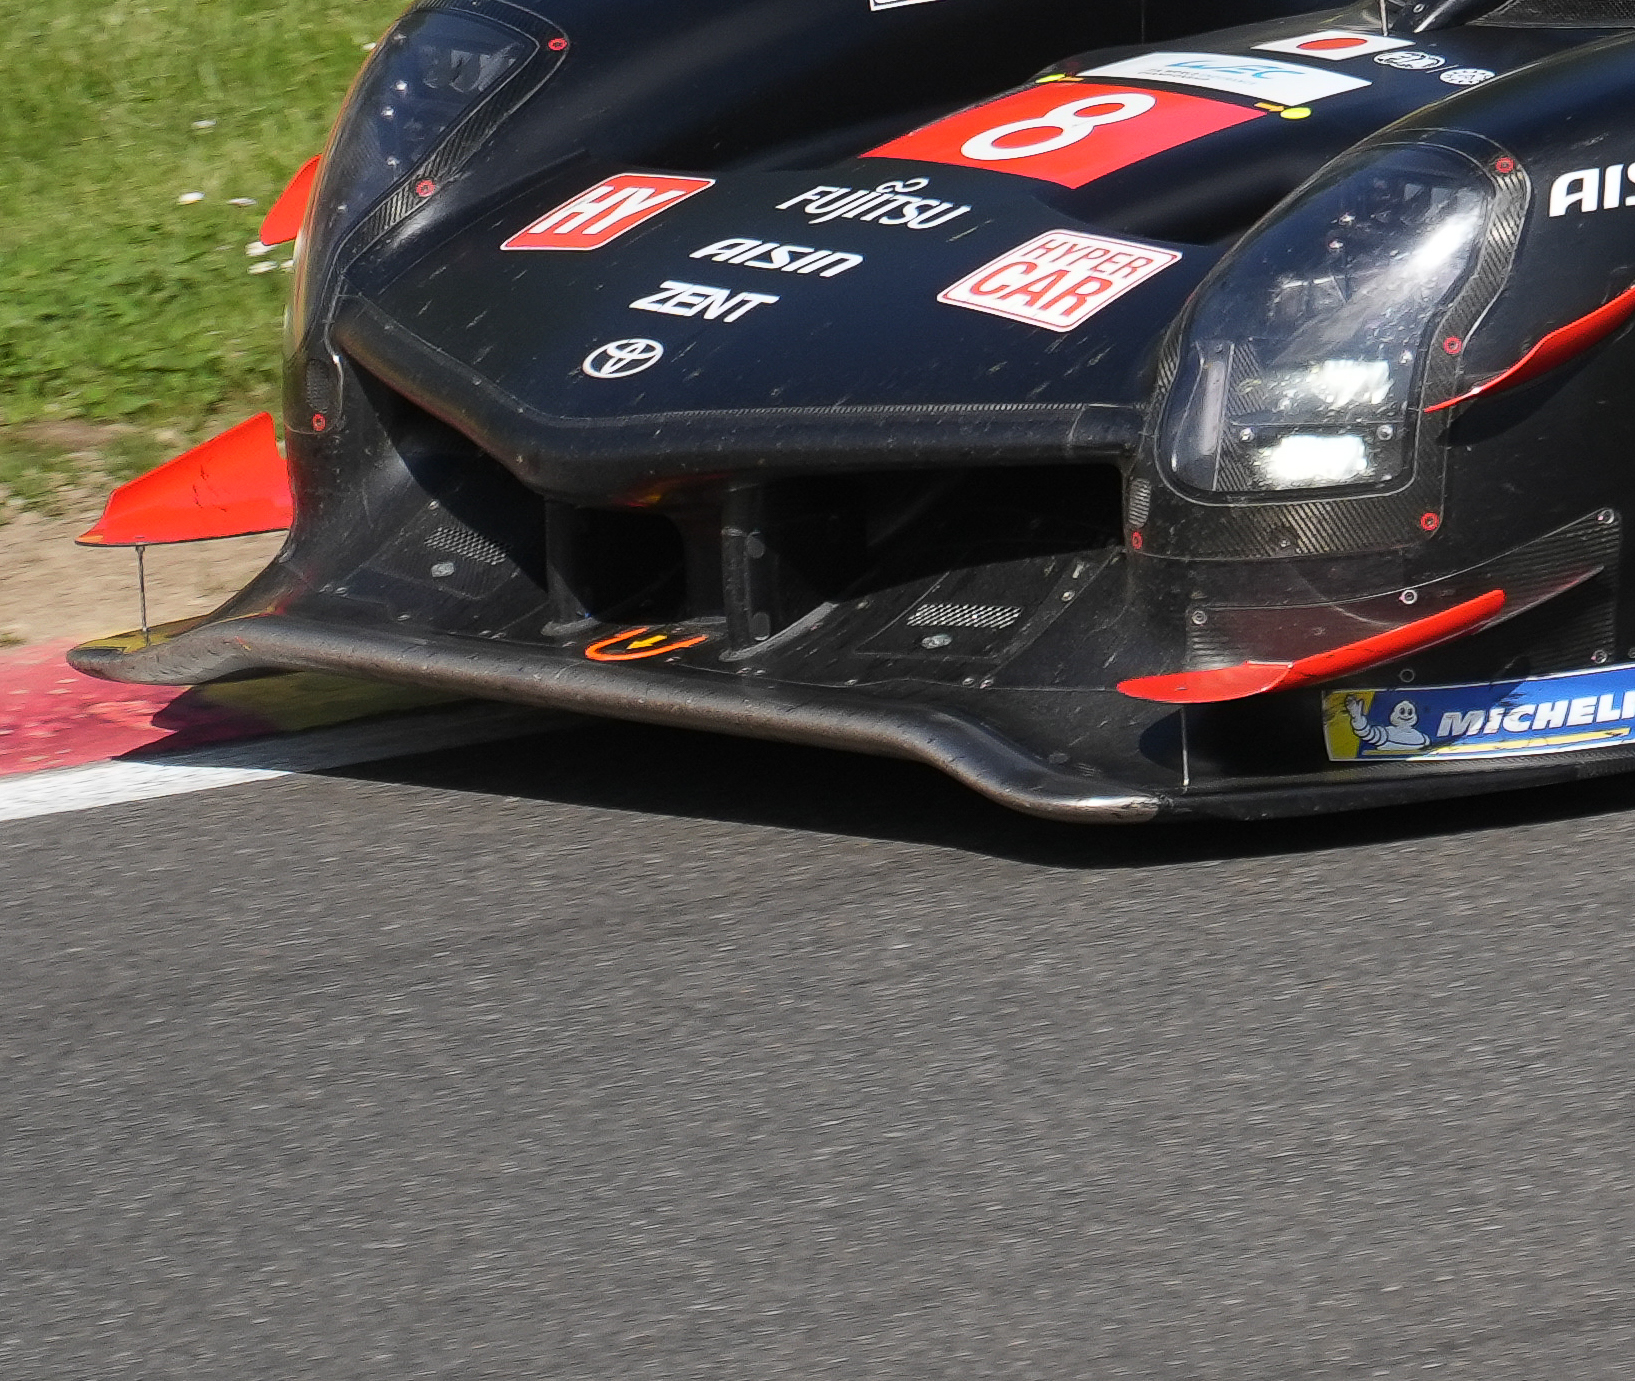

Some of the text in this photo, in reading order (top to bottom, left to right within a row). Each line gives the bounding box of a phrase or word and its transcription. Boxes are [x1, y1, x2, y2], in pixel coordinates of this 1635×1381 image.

[961, 92, 1158, 161] 8
[528, 185, 687, 235] HY
[776, 182, 971, 229] FUJITSU
[689, 238, 864, 278] AISIN
[1023, 238, 1156, 280] HYPER
[629, 280, 781, 323] ZENT
[969, 260, 1114, 318] CAR
